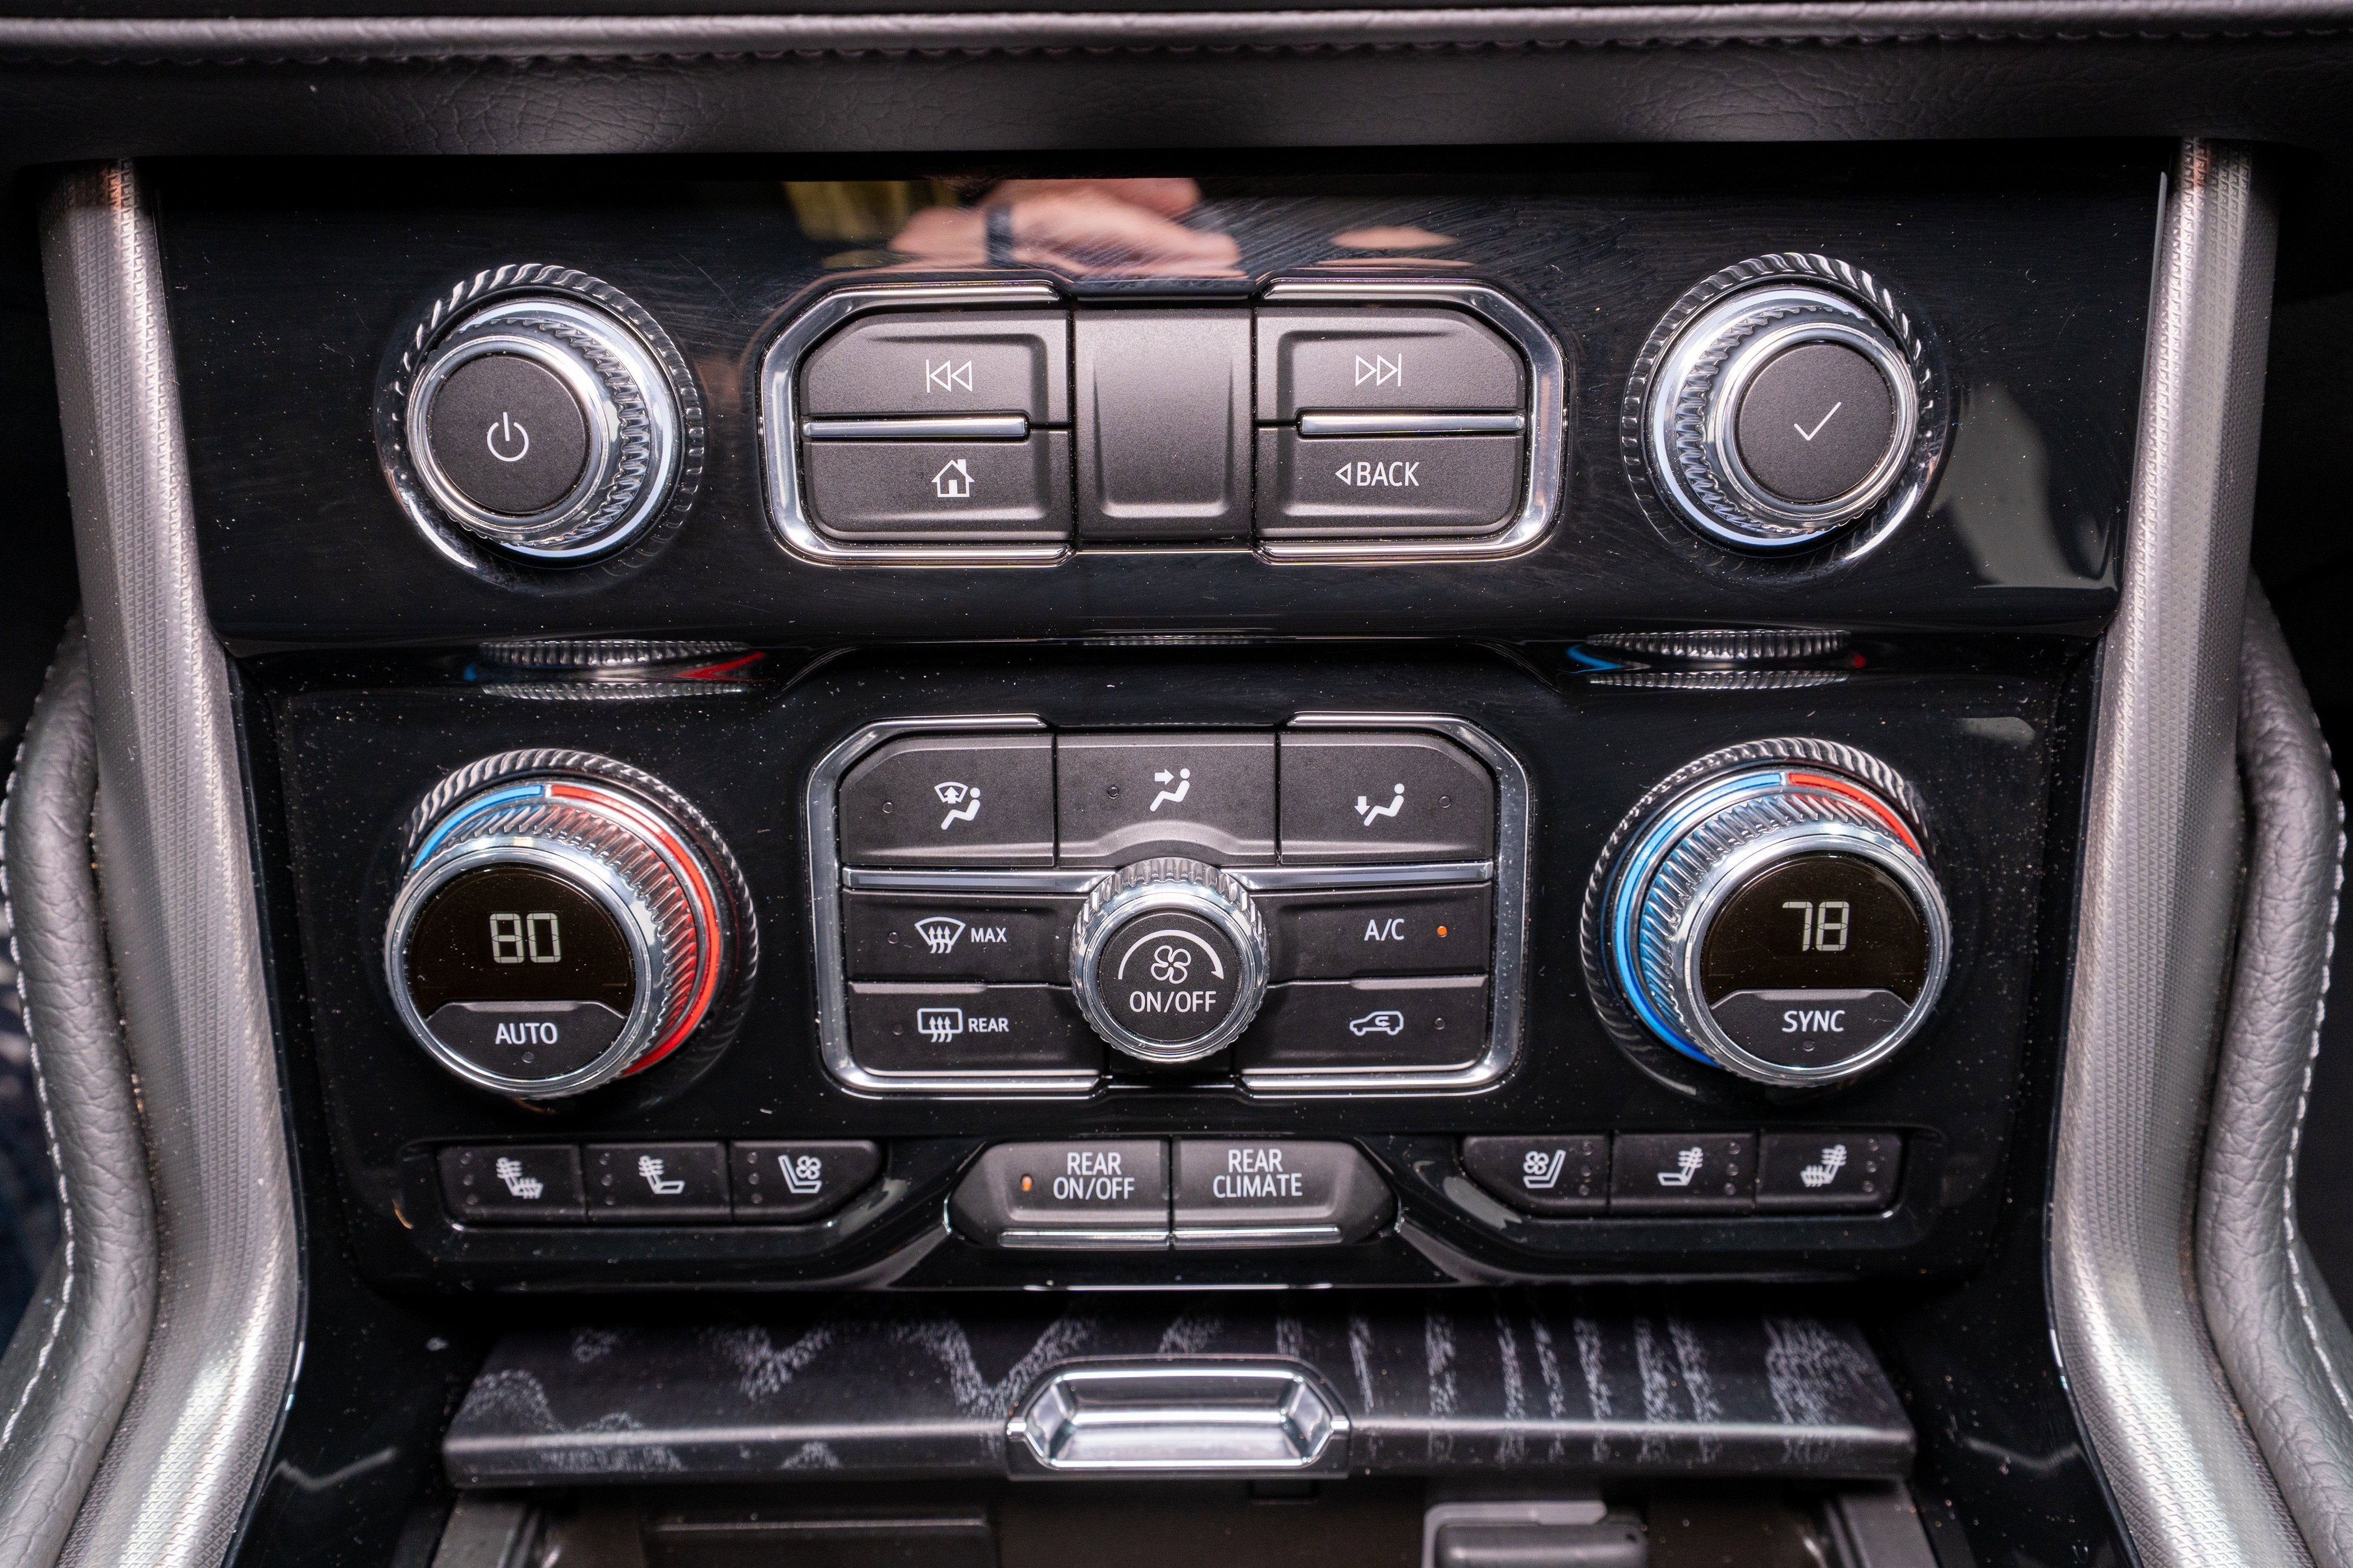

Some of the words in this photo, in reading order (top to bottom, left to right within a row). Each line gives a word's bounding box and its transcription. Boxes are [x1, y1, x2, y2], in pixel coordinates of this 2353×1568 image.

[1356, 461, 1420, 487] BACK
[490, 913, 561, 963] 80
[971, 927, 1008, 943] MAX
[1364, 918, 1405, 941] A/C
[1782, 901, 1850, 951] 78
[1129, 991, 1217, 1013] ON/OFF
[495, 1022, 558, 1045] AUTO
[968, 1017, 1009, 1033] REAR
[1781, 1010, 1845, 1033] SYNC
[1067, 1152, 1122, 1176] REAR
[1228, 1149, 1283, 1173] REAR
[1053, 1176, 1135, 1200] ON/OFF
[1213, 1172, 1303, 1198] CLIMATE
